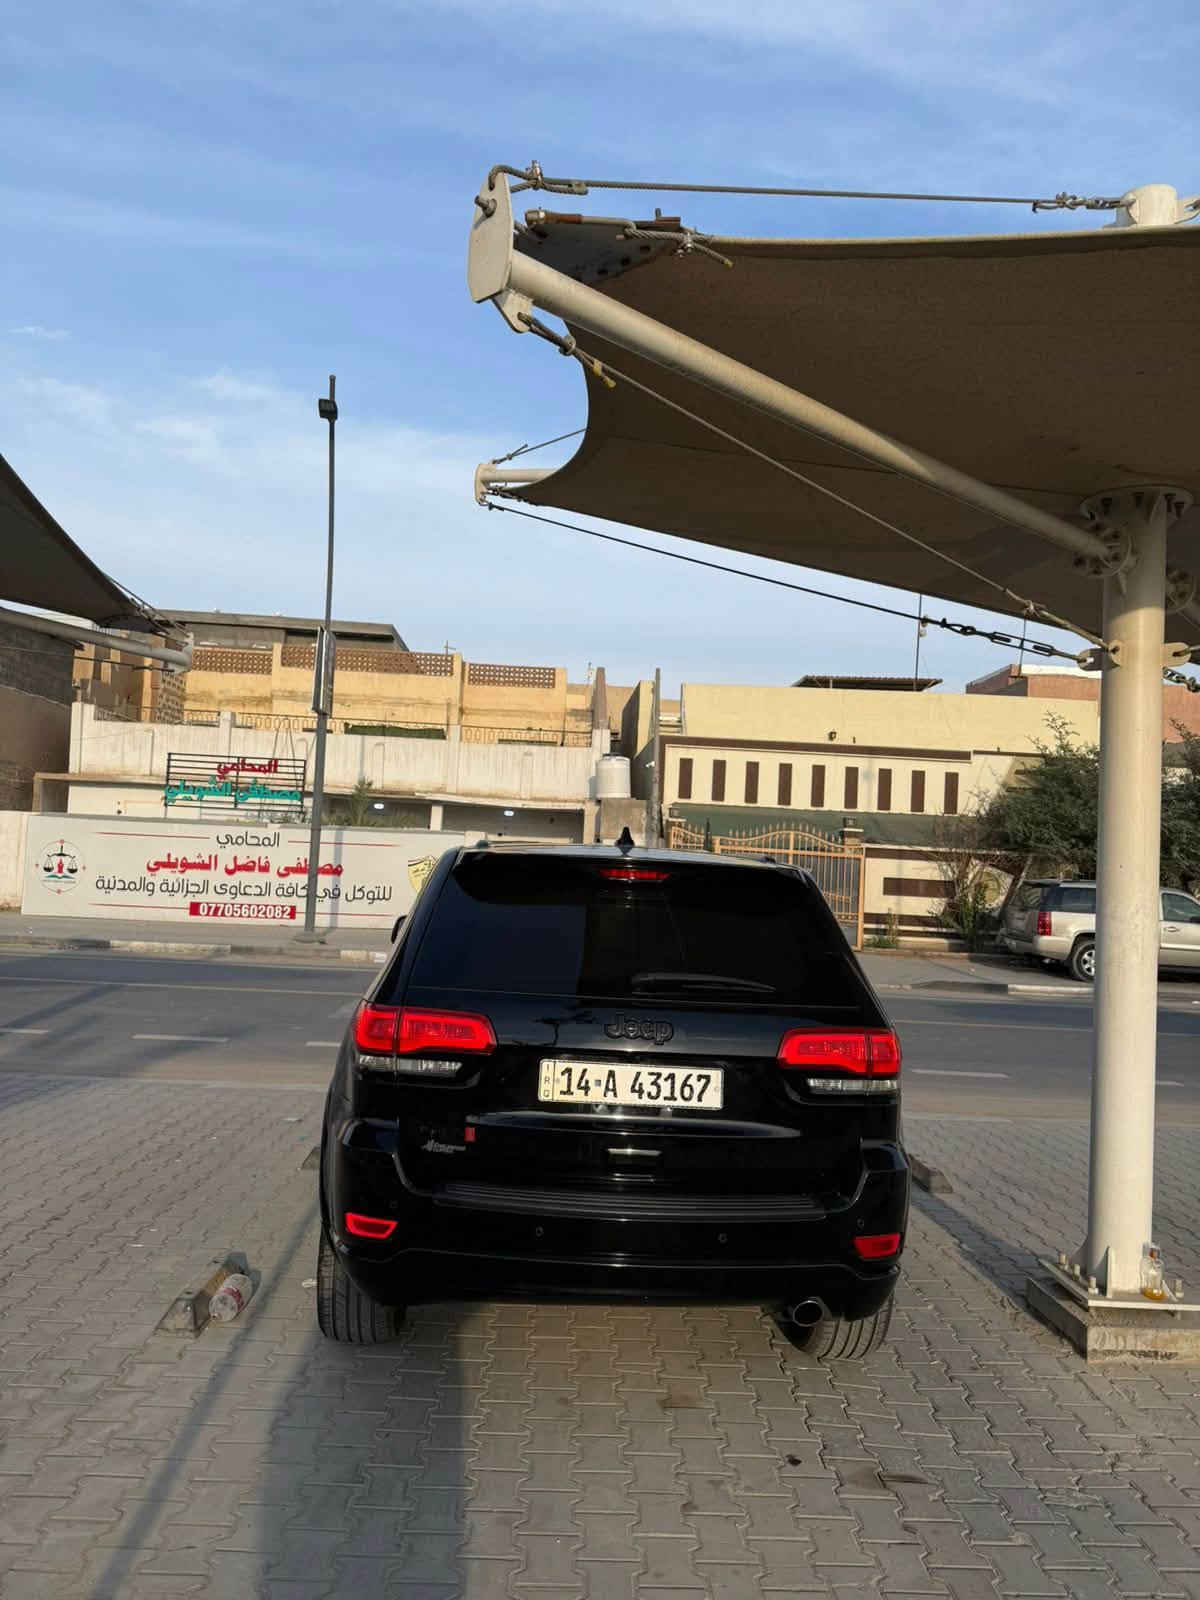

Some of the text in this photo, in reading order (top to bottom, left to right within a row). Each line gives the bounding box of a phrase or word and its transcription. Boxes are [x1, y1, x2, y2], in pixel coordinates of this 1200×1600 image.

[216, 759, 279, 781] المحامي
[164, 775, 233, 805] الشويلي
[216, 831, 280, 849] المحامي
[146, 852, 218, 877] الشويلي
[224, 854, 271, 876] فاضل
[95, 874, 393, 905] للتوكل في كافة الدعاوى الجزائية والمدنية
[199, 903, 291, 920] 07705602082
[604, 1013, 673, 1044] Jeep
[630, 1071, 712, 1103] 43167
